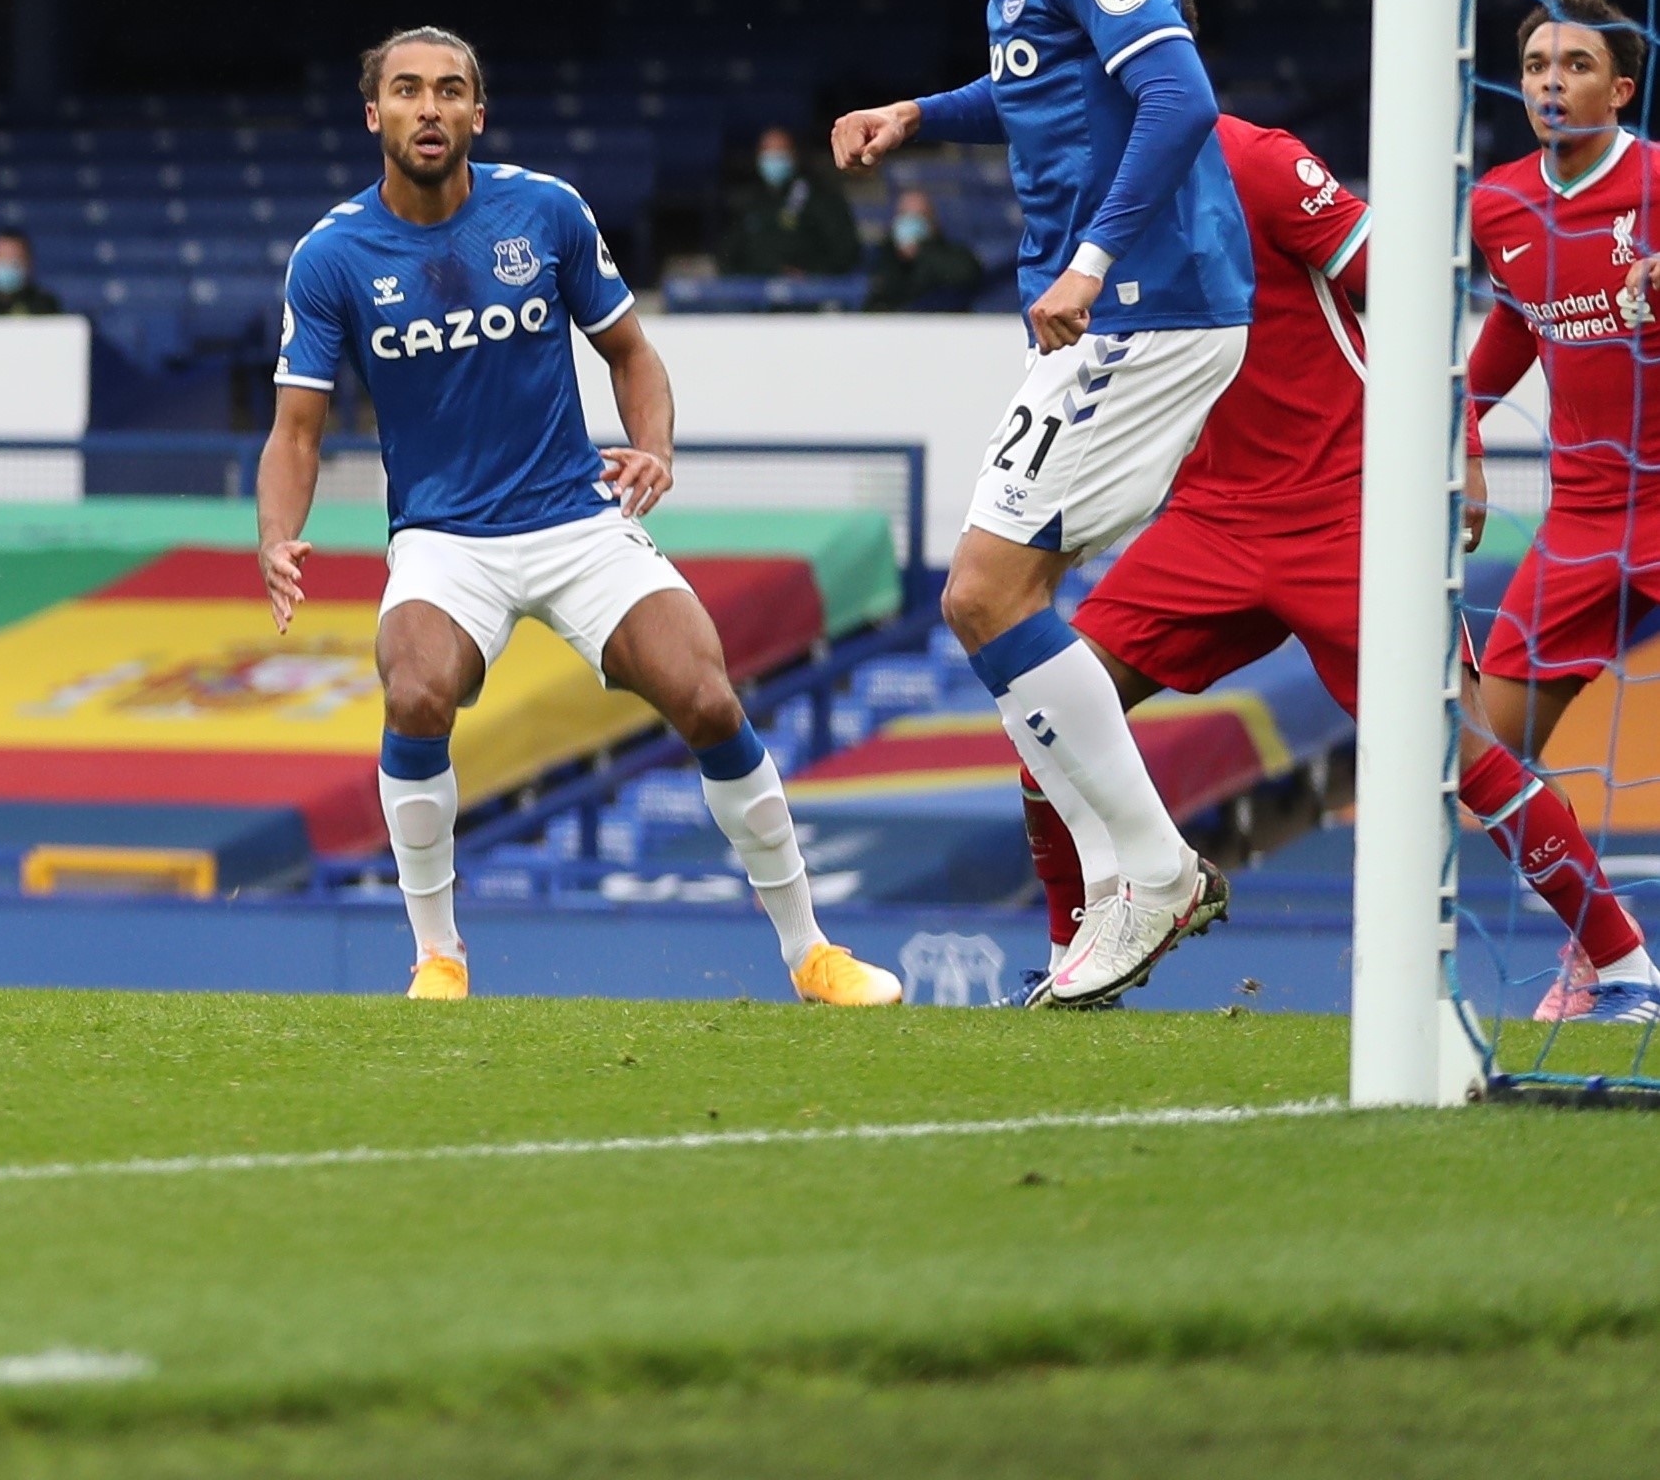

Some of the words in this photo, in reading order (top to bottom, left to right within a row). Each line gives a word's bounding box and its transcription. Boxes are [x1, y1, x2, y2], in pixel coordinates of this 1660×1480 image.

[371, 297, 548, 360] CAZOO
[1522, 288, 1610, 322] Standard
[993, 404, 1063, 481] 21
